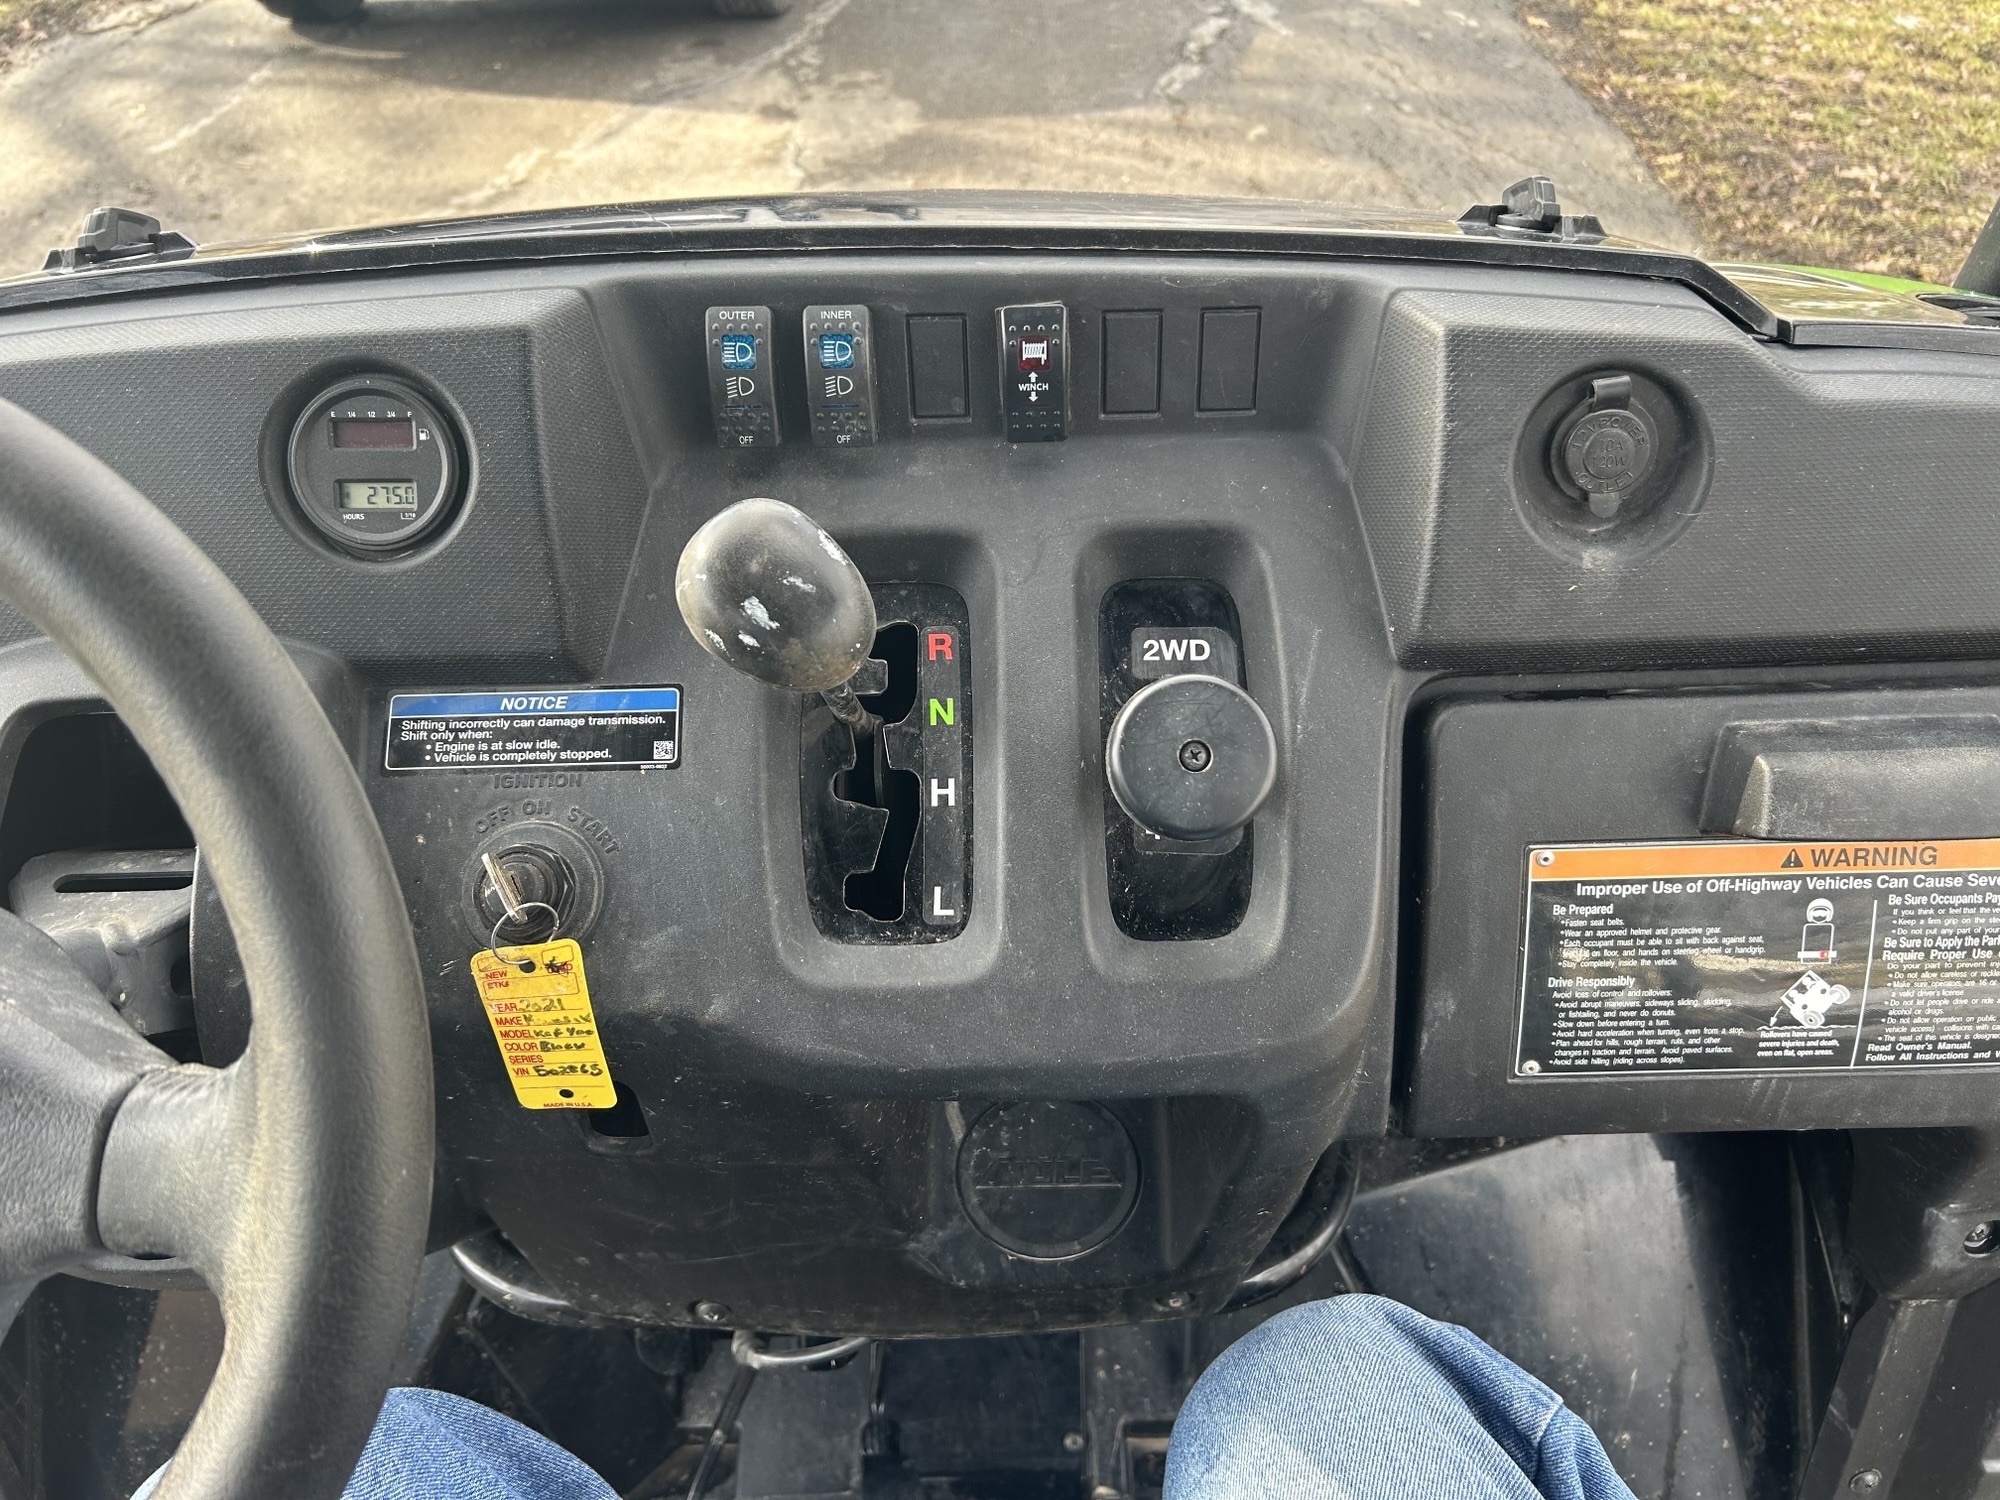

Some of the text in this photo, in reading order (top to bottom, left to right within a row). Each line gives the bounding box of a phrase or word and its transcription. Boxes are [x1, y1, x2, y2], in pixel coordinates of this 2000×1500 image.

[719, 311, 754, 320] OUTER
[820, 310, 852, 320] INNER
[1018, 382, 1048, 391] WINCH
[739, 435, 754, 445] OFF
[836, 434, 851, 444] OFF
[1576, 471, 1634, 491] OUTLET
[367, 487, 414, 504] 275.0
[928, 634, 952, 660] R
[1143, 639, 1211, 661] 2WD
[500, 696, 569, 710] NOTICE
[930, 698, 954, 725] N
[402, 715, 666, 732] Shifting incorrectly can damage transmission.
[401, 730, 493, 741] Shift only when:
[435, 739, 561, 753] Engine is at slow idle.
[434, 749, 612, 762] Vehicle is completely stopped.
[493, 773, 582, 789] IGNITION
[931, 778, 955, 806] H
[474, 800, 548, 833] OFF ON
[567, 806, 622, 854] START
[1811, 846, 1938, 867] WARNING
[1576, 882, 1648, 898] Improper
[1652, 881, 1682, 894] Use
[1686, 880, 1701, 893] of
[1706, 877, 1802, 893] Off-Highway
[1806, 877, 1872, 890] Vehicles
[1877, 875, 1908, 889] Can
[1913, 874, 1963, 887] Cause
[934, 887, 954, 916] L
[1888, 894, 1902, 905] Be
[1904, 894, 1928, 905] Sure
[1930, 893, 1983, 906] Occupants
[1553, 903, 1613, 917] Be Prepared
[1901, 909, 1914, 917] you
[1918, 907, 1934, 915] think
[1565, 919, 1587, 927] Fasten
[1898, 918, 1916, 926] Keep
[1944, 917, 1958, 926] grip
[1596, 928, 1627, 938] approved
[1656, 927, 1668, 935] and
[1671, 926, 1702, 936] protective
[1564, 939, 1580, 947] Each
[1584, 939, 1614, 948] occupant
[1665, 937, 1672, 945] to
[1722, 935, 1746, 945] against
[1884, 937, 1897, 948] Be
[1899, 937, 1921, 948] Sure
[1924, 937, 1933, 947] to
[1935, 936, 1963, 949] Apply
[1965, 935, 1979, 946] the
[1882, 948, 1993, 962] Require Proper Use
[485, 970, 507, 979] NEW
[1548, 975, 1635, 989] Drive Responsibly
[1592, 990, 1600, 998] of
[1601, 990, 1624, 998] control
[1627, 989, 1640, 997] and
[491, 1003, 518, 1012] YEAR
[495, 1017, 523, 1025] MAKE
[1619, 1020, 1645, 1028] entering
[500, 1030, 534, 1038] MODEL
[504, 1043, 538, 1051] COLOR
[1782, 1040, 1805, 1048] injuries
[1868, 1042, 1972, 1051] Read Owner's Manual.
[509, 1055, 543, 1063] SERIES
[1865, 1051, 1991, 1061] Follow All Instructions and
[513, 1068, 530, 1076] VIN
